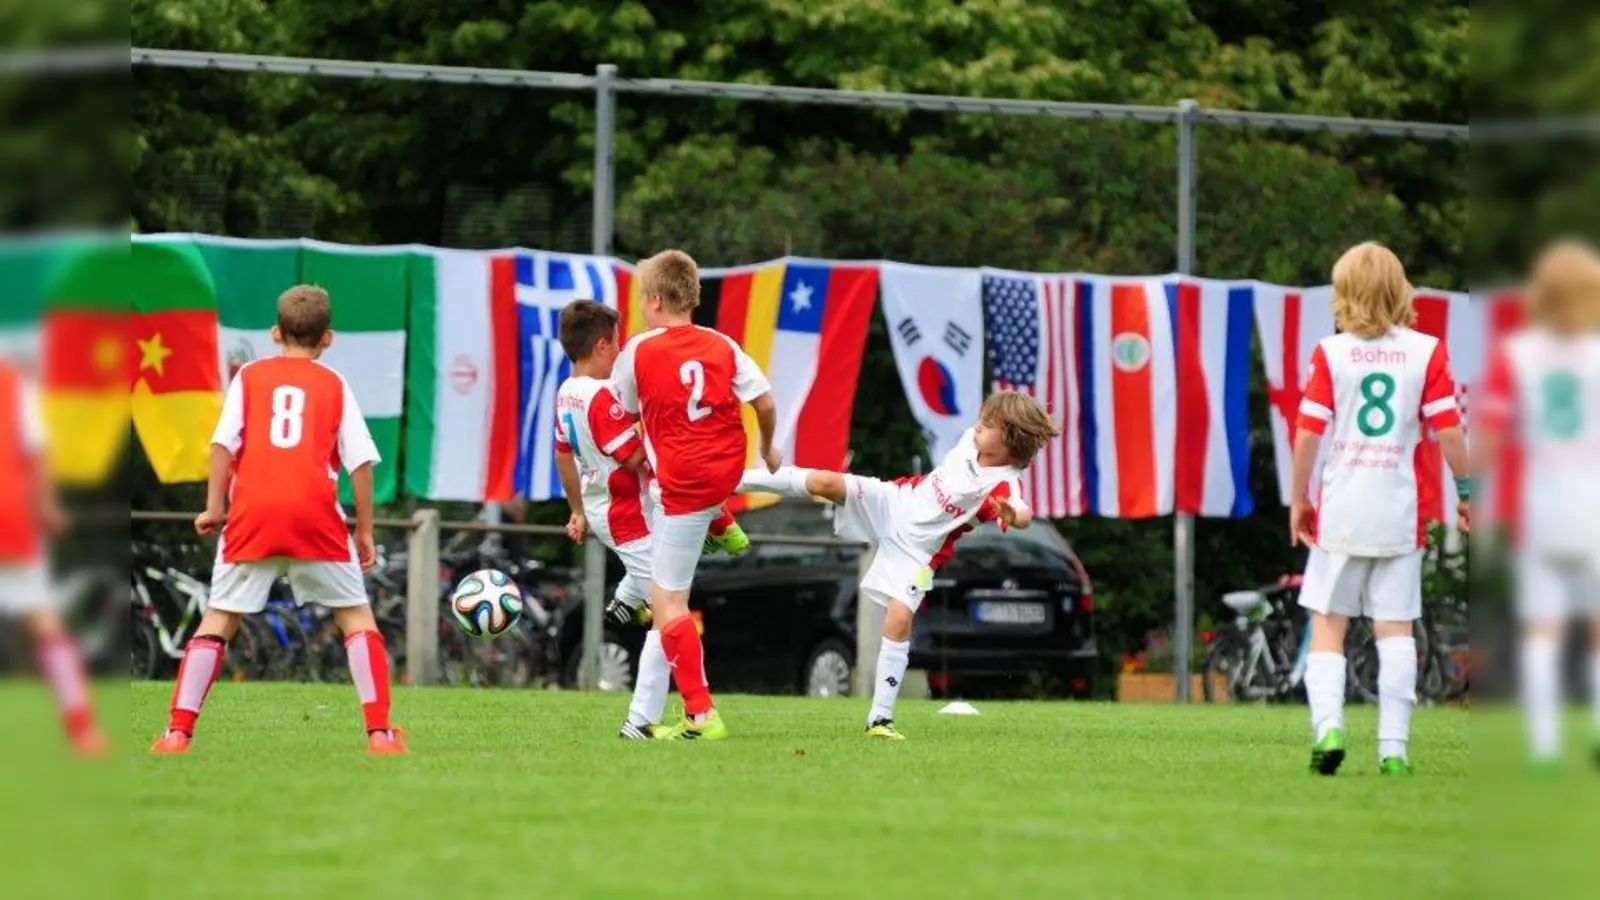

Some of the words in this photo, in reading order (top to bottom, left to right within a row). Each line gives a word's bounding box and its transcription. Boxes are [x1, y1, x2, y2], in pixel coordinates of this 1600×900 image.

[269, 384, 306, 449] 8
[679, 359, 712, 422] 2
[1356, 371, 1395, 437] 8
